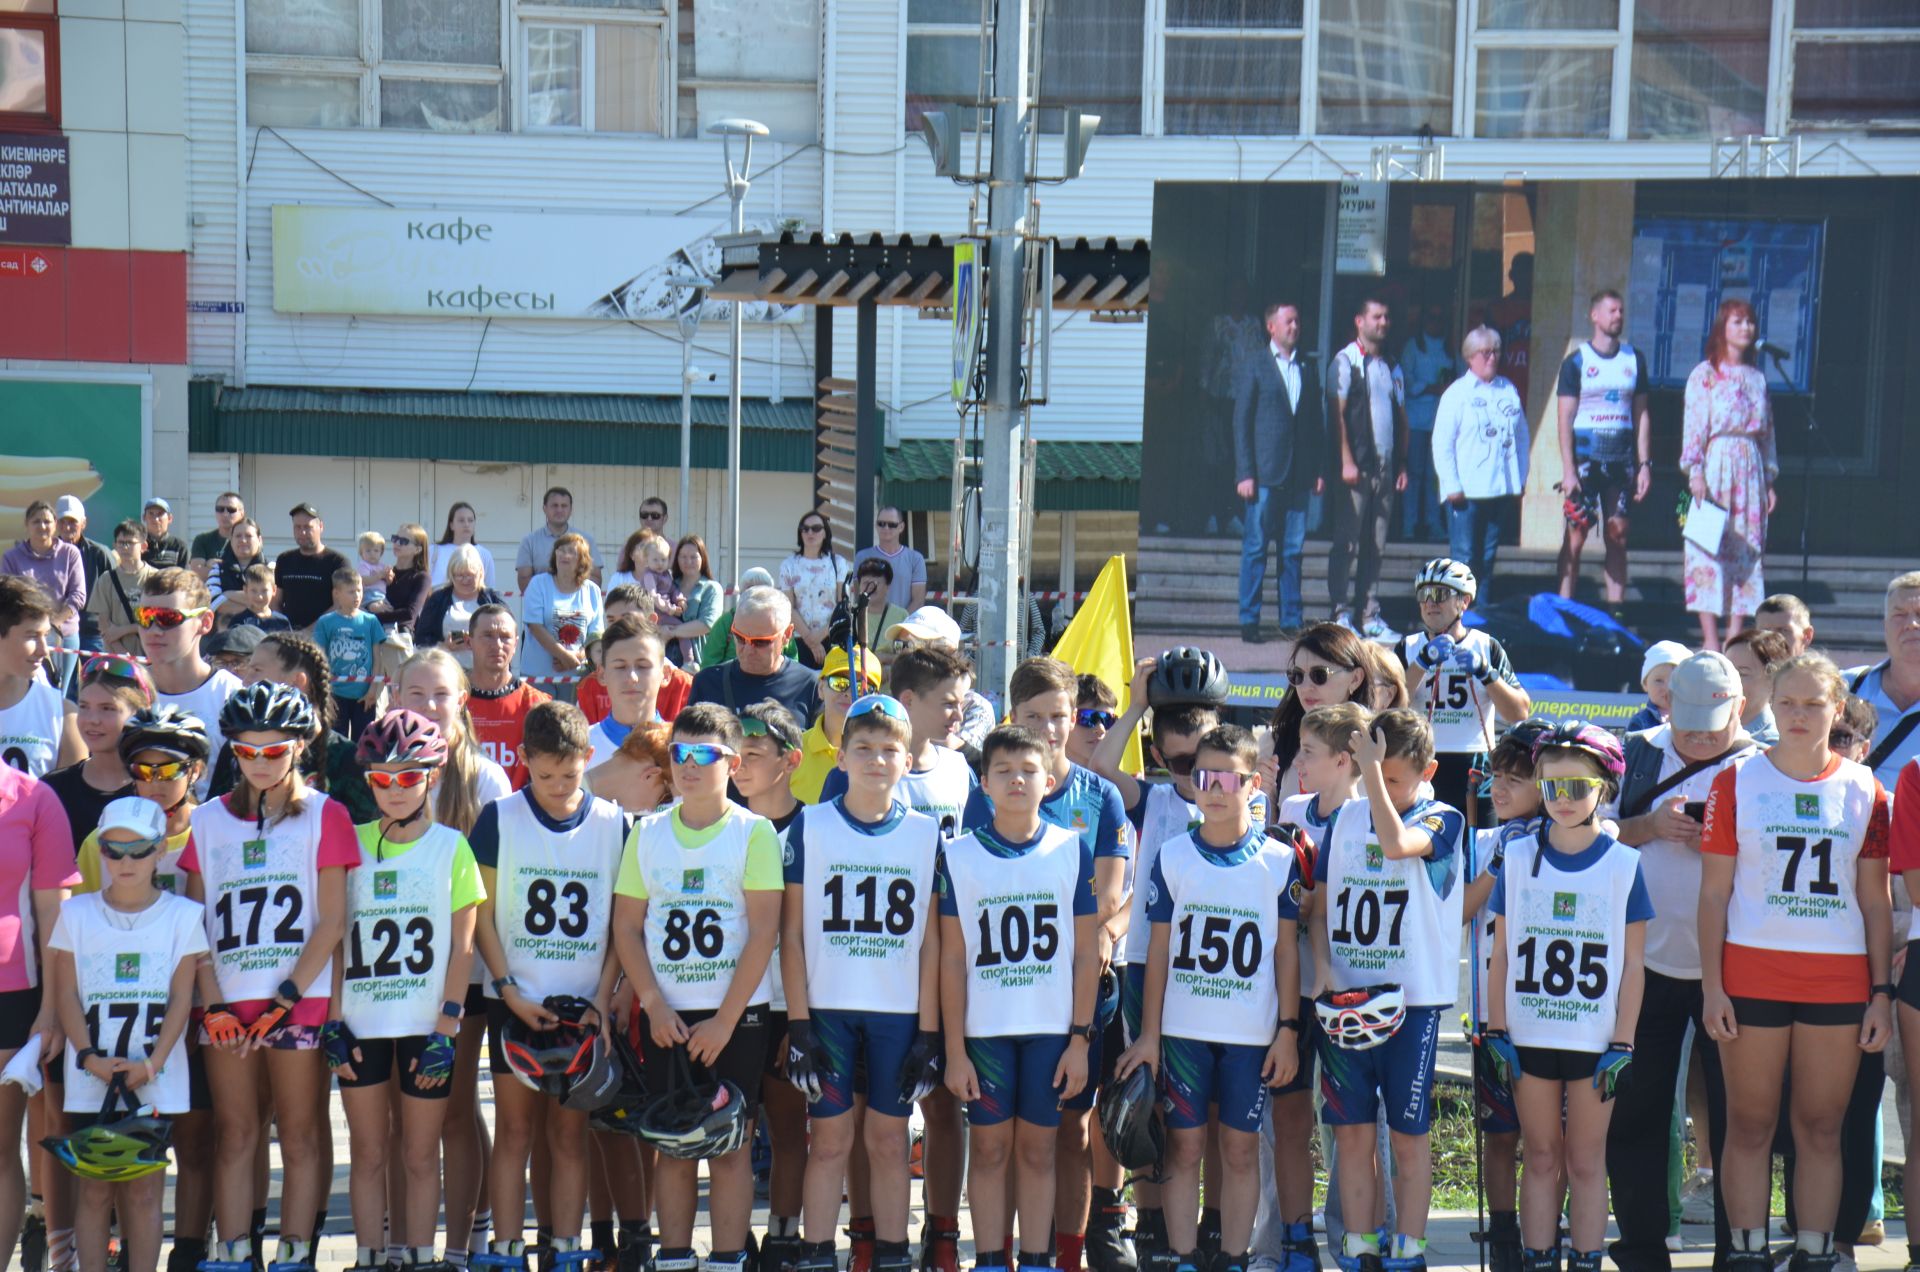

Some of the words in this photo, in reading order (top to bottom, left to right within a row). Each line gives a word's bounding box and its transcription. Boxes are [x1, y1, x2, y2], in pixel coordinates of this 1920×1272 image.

[1, 146, 66, 164] КИЕМНӘРЕ
[407, 216, 493, 245] кафе
[427, 283, 554, 312] кафесы
[1264, 687, 1285, 699] по
[1425, 675, 1468, 709] 15
[1529, 700, 1648, 720] уперспринт"
[1765, 825, 1820, 835] АГРЫЗСКИЙ
[1822, 828, 1850, 839] РАЙОН
[519, 867, 569, 877] АГРЫЗСКИЙ
[571, 870, 598, 879] РАЙОН
[830, 864, 882, 873] АГРЫЗСКИЙ
[884, 865, 911, 876] РАЙОН
[1776, 836, 1838, 896] 71
[268, 872, 298, 882] РАЙОН
[1342, 876, 1380, 887] РЫЗСИЙ
[1381, 877, 1406, 887] РАЙОН
[1026, 892, 1054, 901] РАЙОН
[353, 906, 397, 918] РЫЗСКИЙ
[400, 904, 429, 914] РАЙОН
[525, 878, 589, 938] 83
[661, 900, 703, 908] ЫЗСКИЙ
[705, 900, 733, 908] РАЙОН
[823, 874, 915, 936] 118
[215, 884, 304, 953] 172
[1183, 904, 1231, 914] АГРЫЗСКИЙ
[1232, 908, 1260, 919] РАЙОН
[1331, 886, 1409, 946] 107
[1787, 907, 1829, 919] ЖИЗНИ
[663, 908, 724, 961] 86
[975, 904, 1059, 967] 105
[1525, 926, 1573, 937] АГРЫЗСКИЙ
[1575, 929, 1604, 940] РАЙОН
[345, 916, 434, 980] 123
[848, 947, 886, 958] ЖИЗНИ
[1173, 914, 1263, 978] 150
[535, 950, 576, 960] ЖИЗНИ
[240, 958, 279, 972] ЖИЗНИ
[1349, 958, 1386, 970] ЖИЗНИ
[1515, 936, 1608, 1000] 185
[676, 972, 716, 984] ЖИЗНИ
[1001, 977, 1033, 988] ЖИЗНИ
[372, 990, 408, 1002] ЖИЗНИ
[1191, 986, 1231, 999] ЖИЗНИ
[1537, 1008, 1578, 1022] ЖИЗНИ
[85, 1003, 167, 1060] 175
